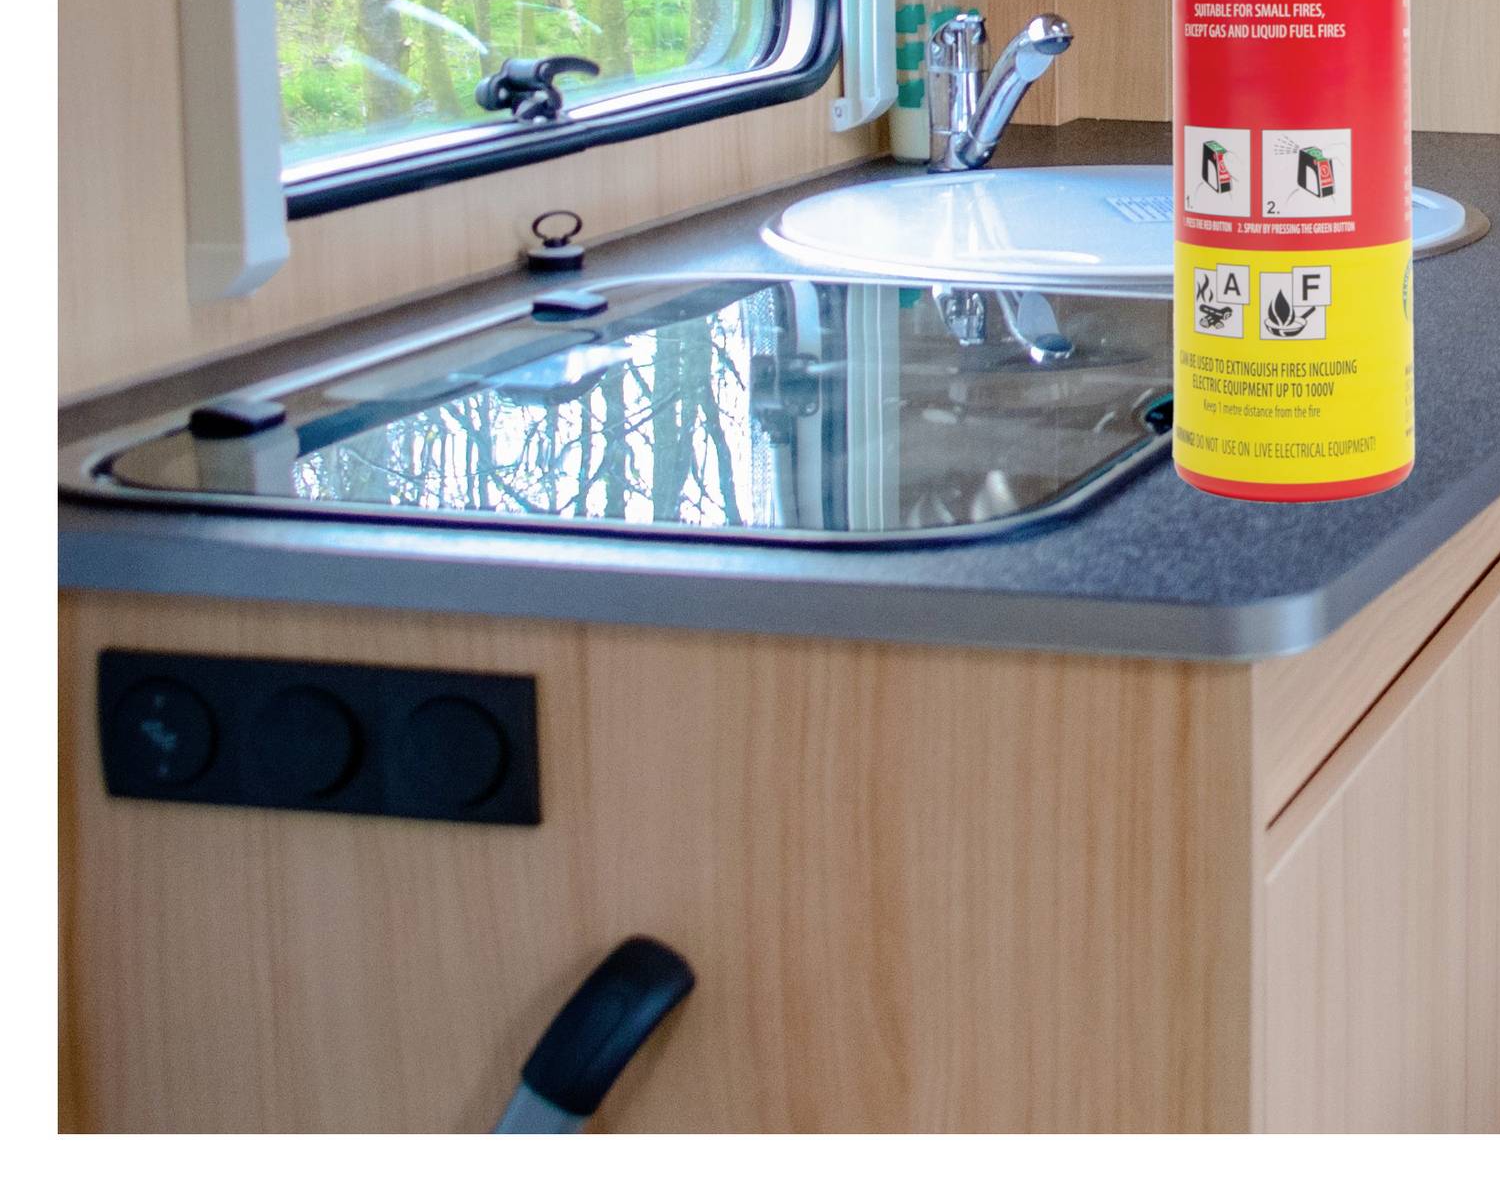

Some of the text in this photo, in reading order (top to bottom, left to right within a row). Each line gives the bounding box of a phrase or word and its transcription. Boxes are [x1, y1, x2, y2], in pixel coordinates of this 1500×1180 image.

[1194, 3, 1325, 19] SUITABLE FOR SMALL FIRES,
[1209, 23, 1226, 38] GAS
[1227, 24, 1249, 38] AND
[1251, 24, 1287, 39] LIQUID
[1289, 24, 1316, 38] FUEL
[1318, 23, 1346, 38] FIRES
[1266, 201, 1280, 215] 2.
[1223, 272, 1241, 296] A
[1302, 274, 1320, 300] F
[1197, 355, 1214, 372] USED
[1215, 358, 1224, 374] TO
[1226, 360, 1278, 377] EXTINGUISH
[1280, 362, 1306, 377] FIRES
[1309, 359, 1357, 377] INCLUDING
[1192, 373, 1334, 398] ELECTRIC EQUIPMENT UP TO 1000V
[1223, 404, 1242, 415] metre
[1243, 403, 1273, 417] distance
[1274, 404, 1292, 418] from
[1294, 405, 1306, 418] the
[1308, 404, 1320, 417] fire
[1205, 437, 1219, 453] NOT
[1222, 439, 1236, 455] USE
[1238, 440, 1250, 456] ON
[1254, 441, 1273, 458] LIVE
[1275, 441, 1326, 459] ELECTRICAL
